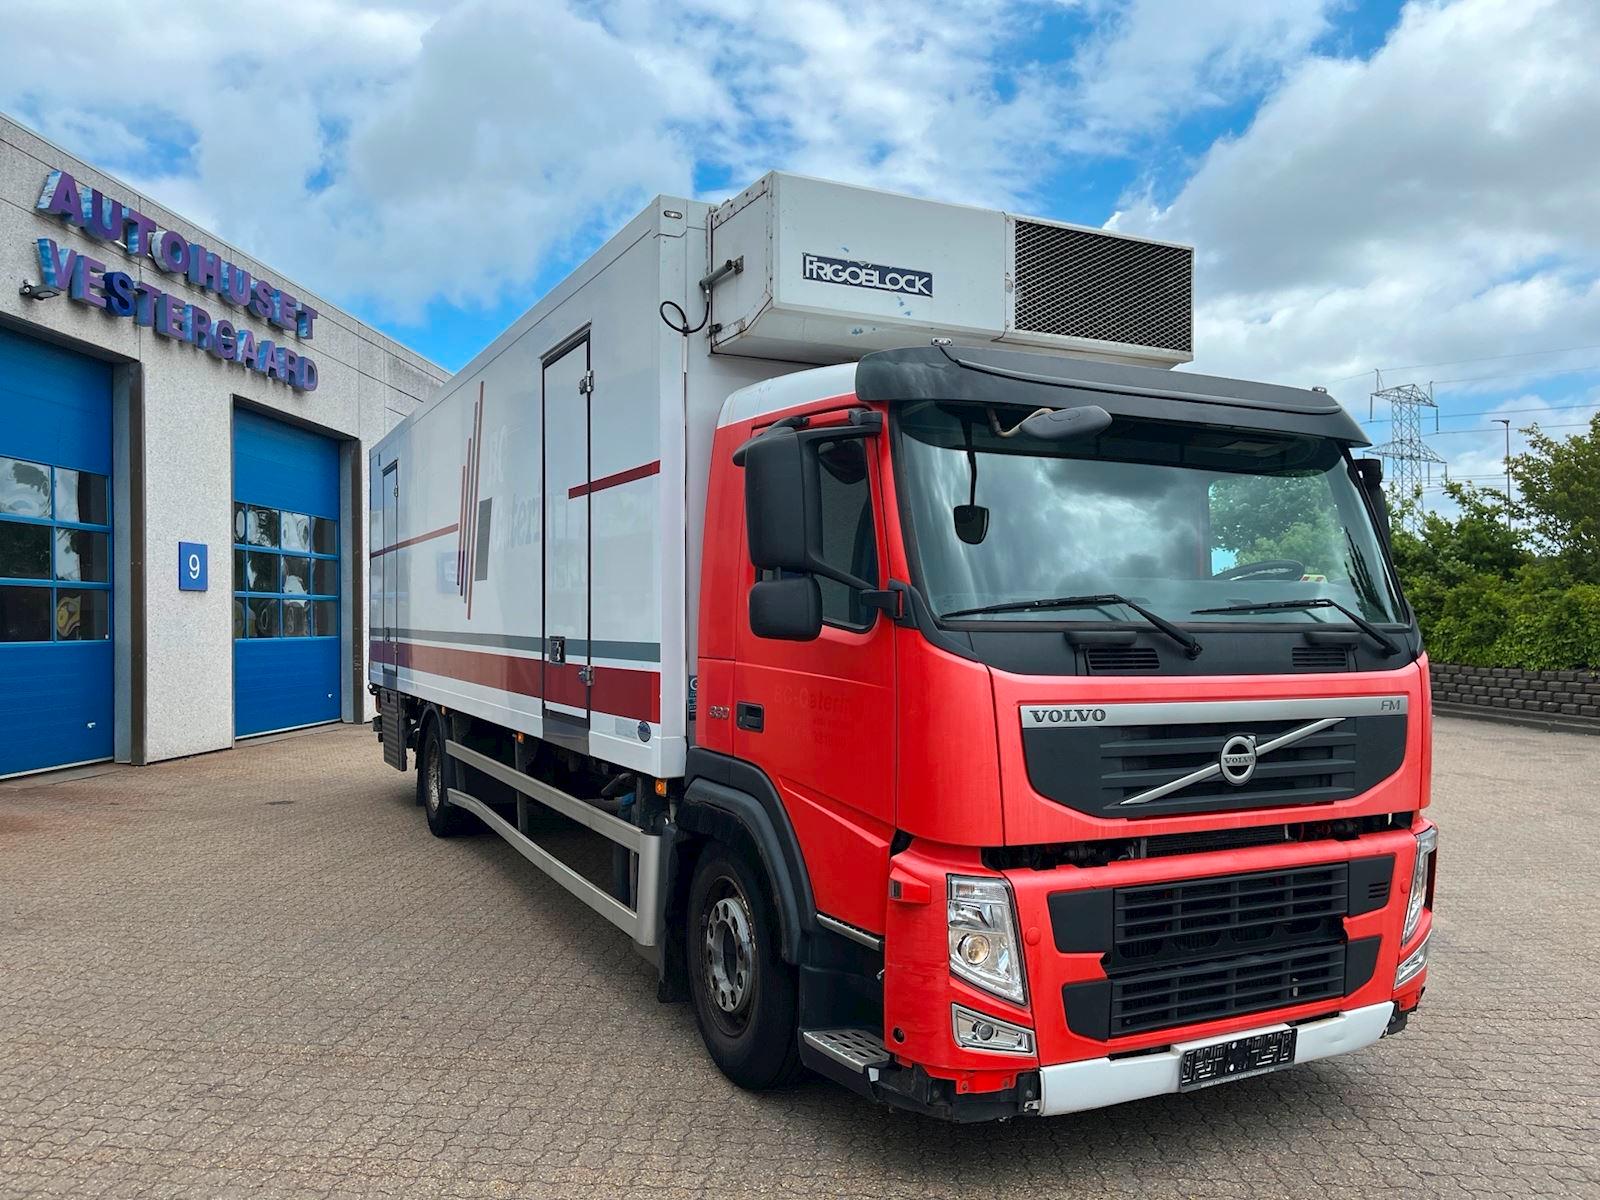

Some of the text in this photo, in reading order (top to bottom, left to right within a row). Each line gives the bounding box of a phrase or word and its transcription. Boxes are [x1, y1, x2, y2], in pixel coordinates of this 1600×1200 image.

[36, 169, 319, 340] AUTOHUSET
[804, 255, 931, 295] FRIGOBLOCK
[34, 238, 319, 392] VESTERGAARD
[188, 553, 200, 580] 9
[1029, 708, 1106, 723] VOLVO
[1381, 699, 1401, 711] FM
[1223, 756, 1255, 764] VOLVO
